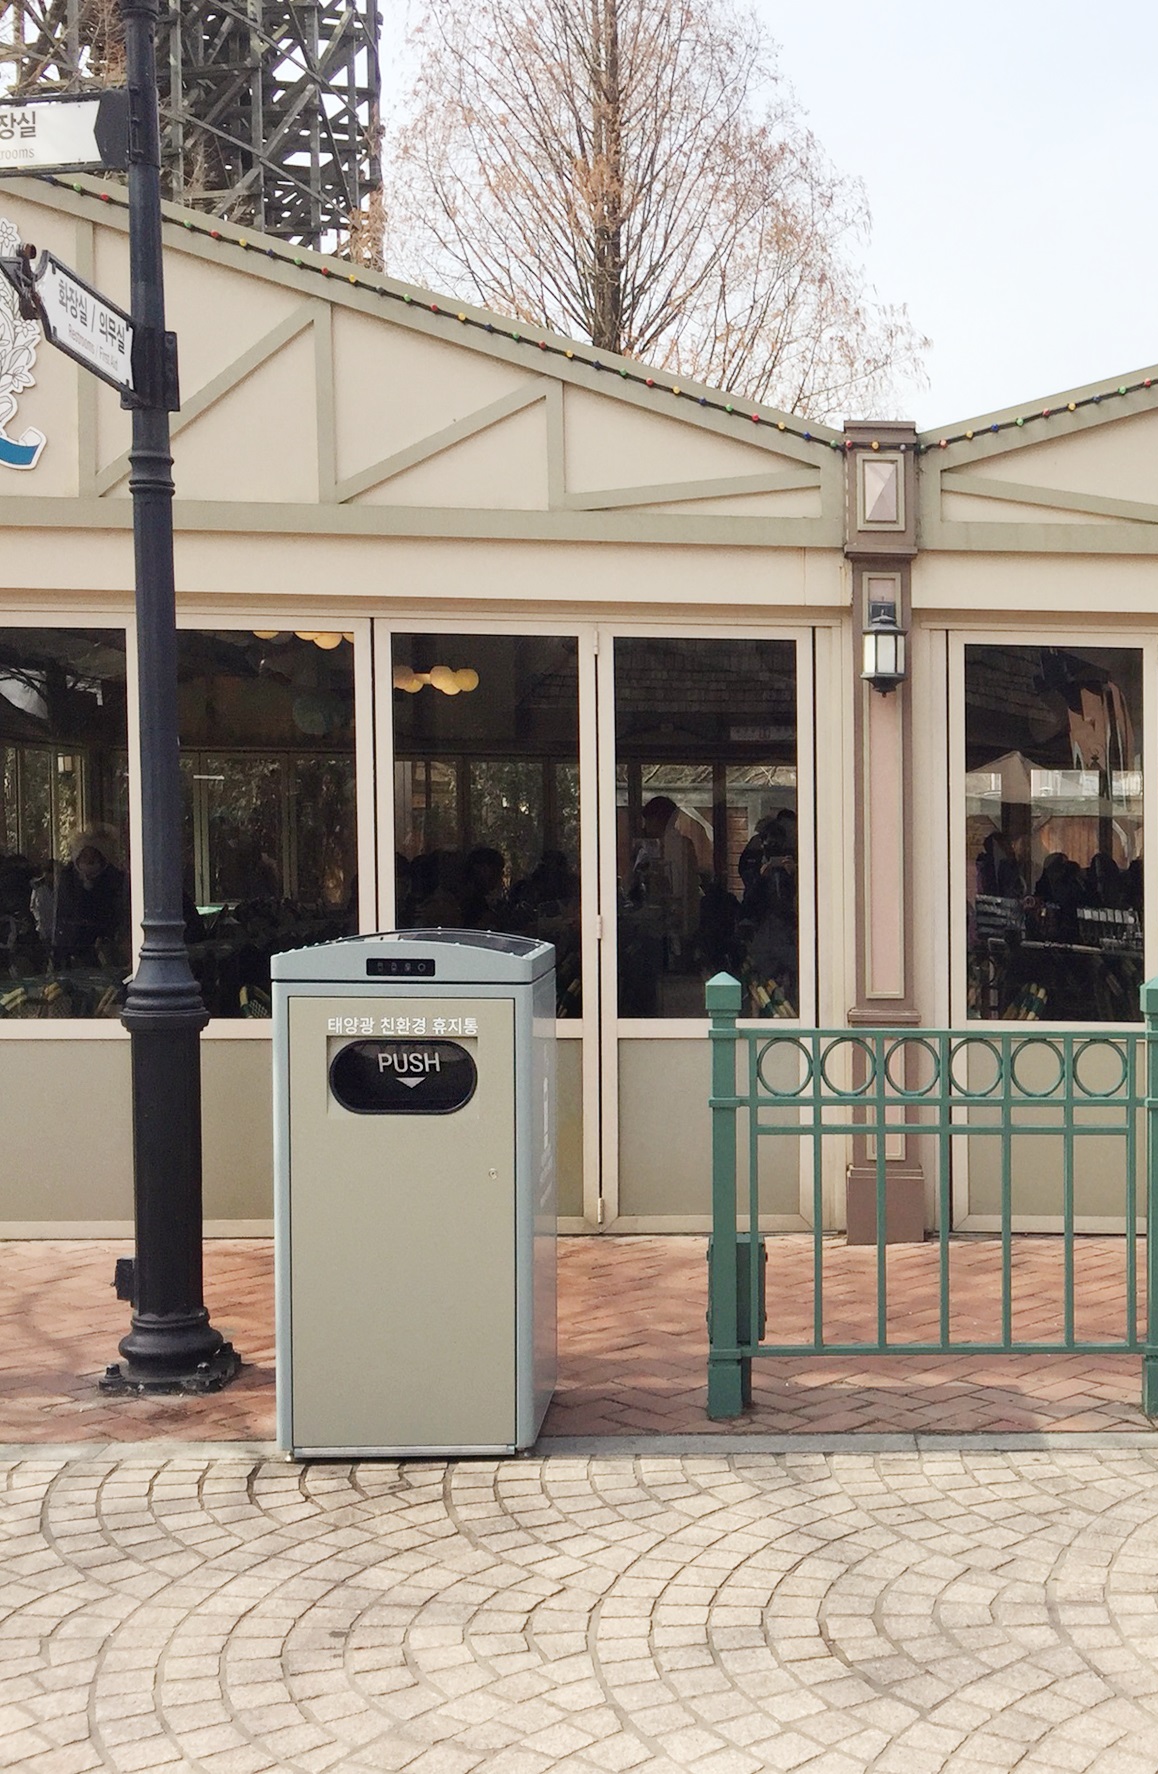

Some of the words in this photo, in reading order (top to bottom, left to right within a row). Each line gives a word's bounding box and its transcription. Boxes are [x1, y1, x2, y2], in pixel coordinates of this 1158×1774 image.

[59, 278, 88, 328] 화장실
[99, 311, 125, 355] 의무실
[327, 1017, 375, 1034] 태양광
[380, 1017, 427, 1035] 친환경
[432, 1017, 479, 1035] 휴지통
[378, 1052, 441, 1073] PUSH
